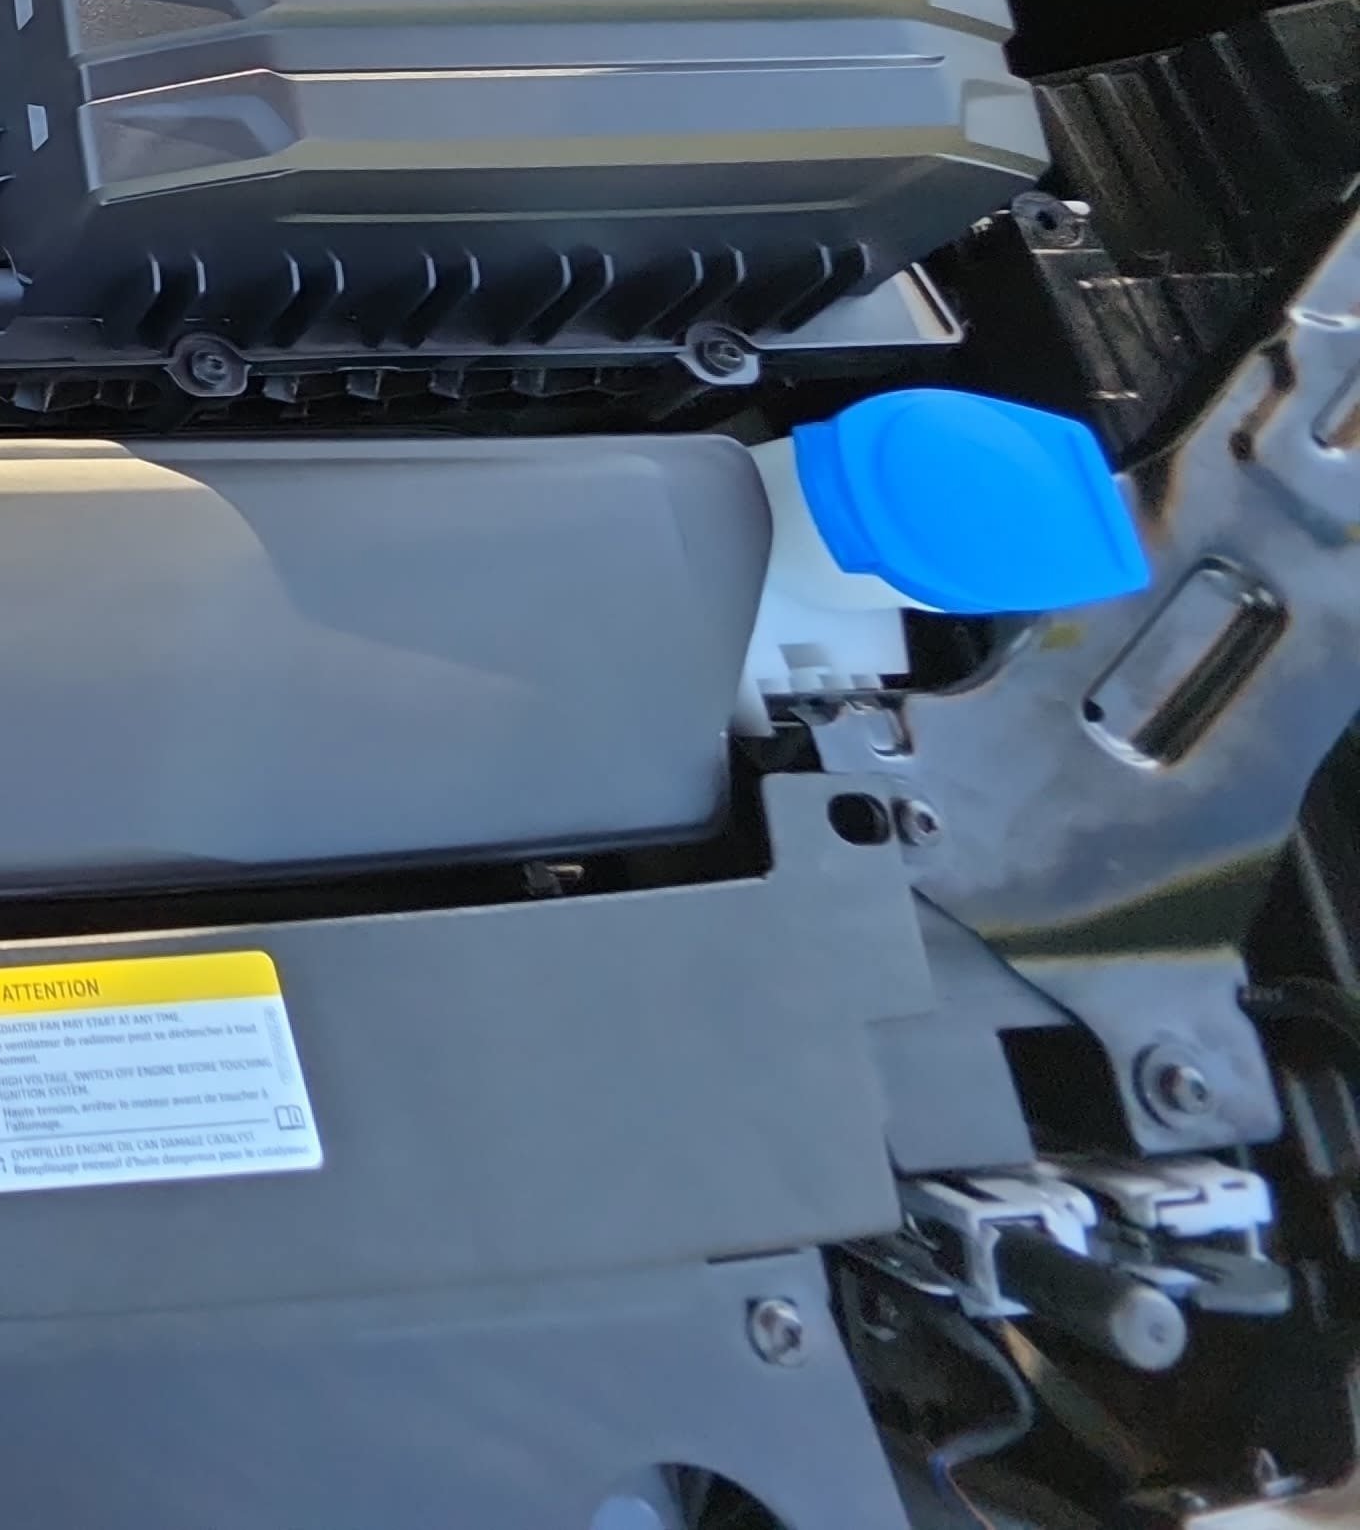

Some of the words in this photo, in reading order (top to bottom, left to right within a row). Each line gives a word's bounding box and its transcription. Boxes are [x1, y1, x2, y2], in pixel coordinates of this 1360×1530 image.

[2, 978, 100, 1003] ATTENTION
[40, 1021, 61, 1031] FAN
[63, 1019, 84, 1030] MAY
[86, 1016, 115, 1028] START
[119, 1015, 130, 1025] AT
[134, 1014, 153, 1025] ANY
[0, 1088, 46, 1101] IGNITION
[11, 1144, 74, 1160] OVERFILLED
[136, 1139, 159, 1151] CAN
